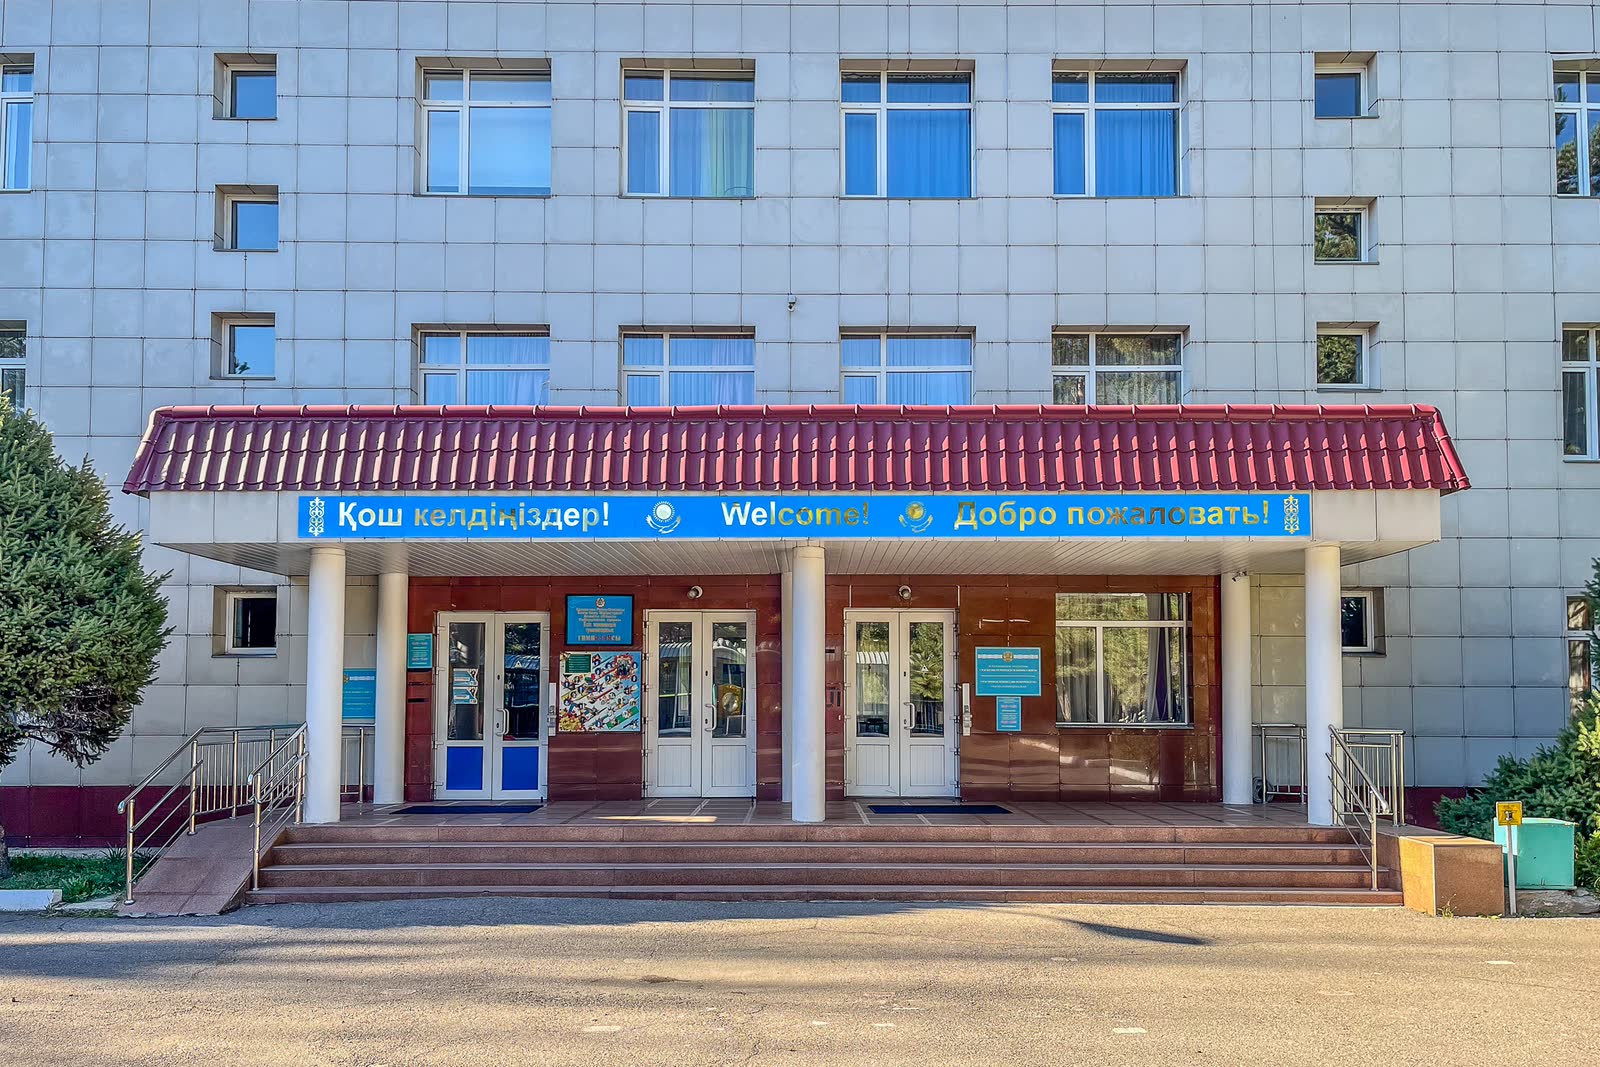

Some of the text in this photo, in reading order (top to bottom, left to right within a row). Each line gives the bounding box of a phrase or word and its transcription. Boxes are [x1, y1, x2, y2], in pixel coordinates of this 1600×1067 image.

[339, 501, 609, 532] Қош келдіңіздер!
[721, 501, 869, 526] Welcome!
[954, 500, 1269, 531] Добро пожаловать!
